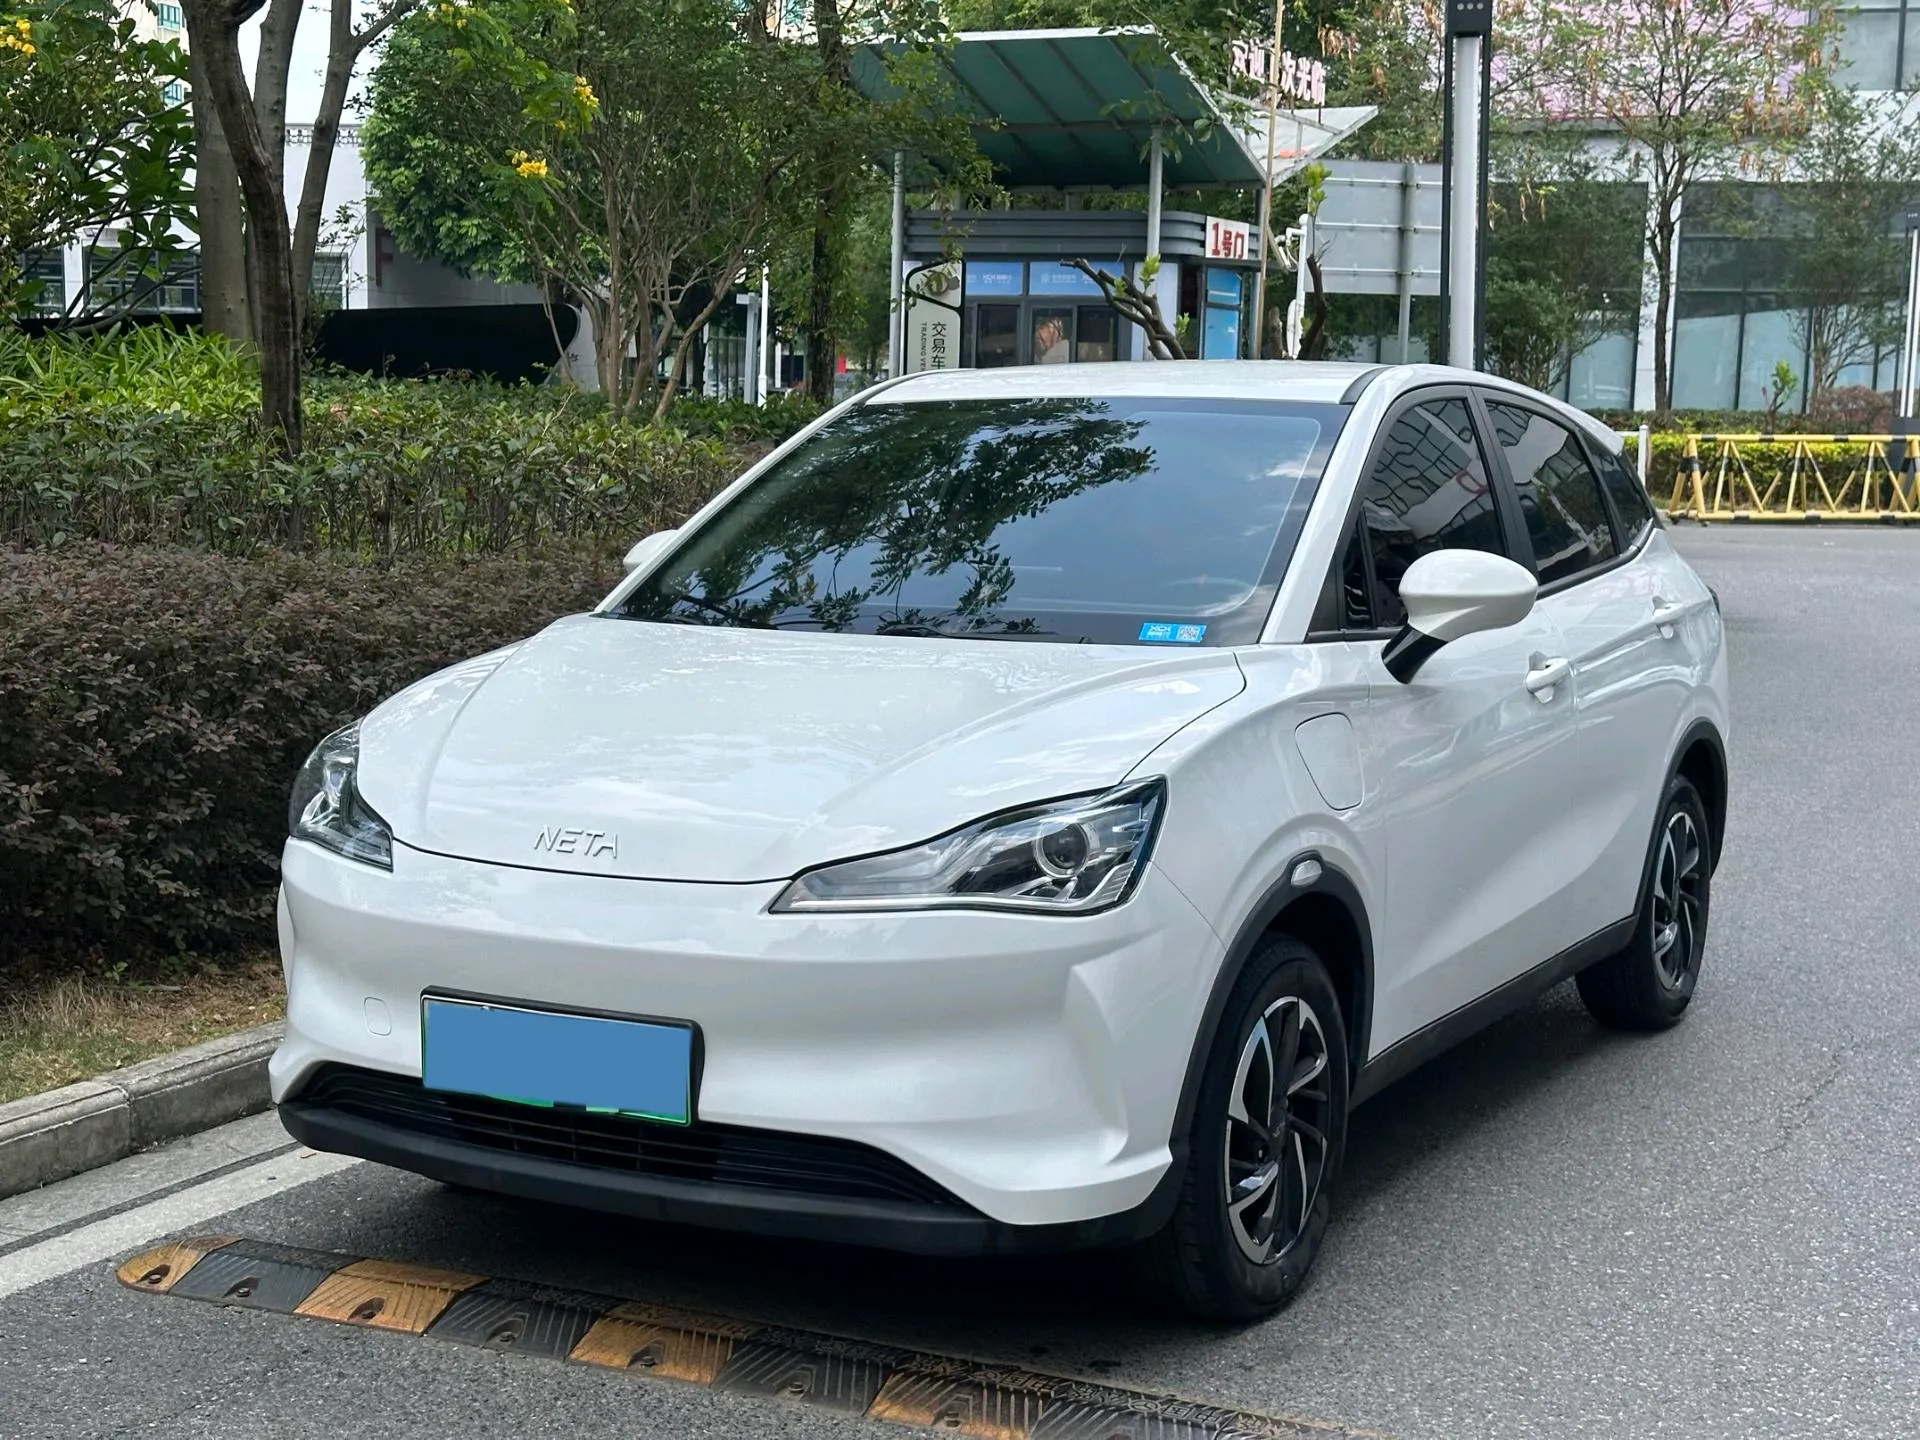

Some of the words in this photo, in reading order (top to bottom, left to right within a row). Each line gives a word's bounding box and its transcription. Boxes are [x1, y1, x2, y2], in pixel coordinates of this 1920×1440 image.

[1231, 37, 1327, 106] 欢迎次光临
[1211, 222, 1245, 259] 1号门
[920, 322, 928, 356] TRADING
[931, 321, 947, 369] 交易车
[533, 824, 618, 860] NETA
